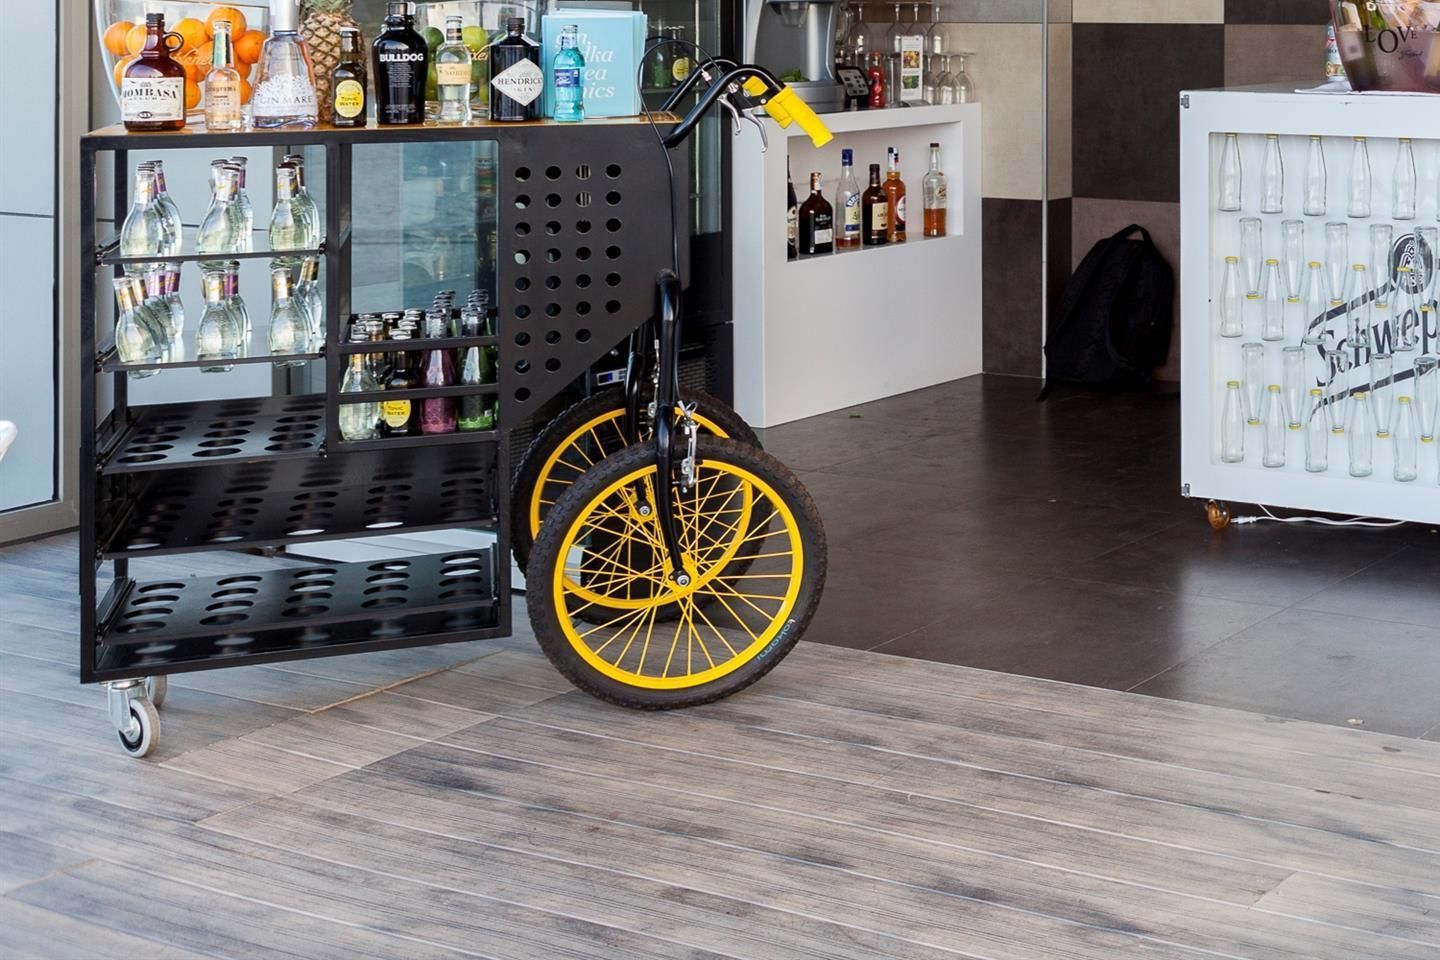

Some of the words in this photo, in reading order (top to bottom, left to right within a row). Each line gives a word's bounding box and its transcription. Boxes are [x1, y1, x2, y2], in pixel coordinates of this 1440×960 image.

[1363, 24, 1418, 53] LOVE
[380, 53, 424, 62] BULLDOG
[260, 96, 279, 104] GIN
